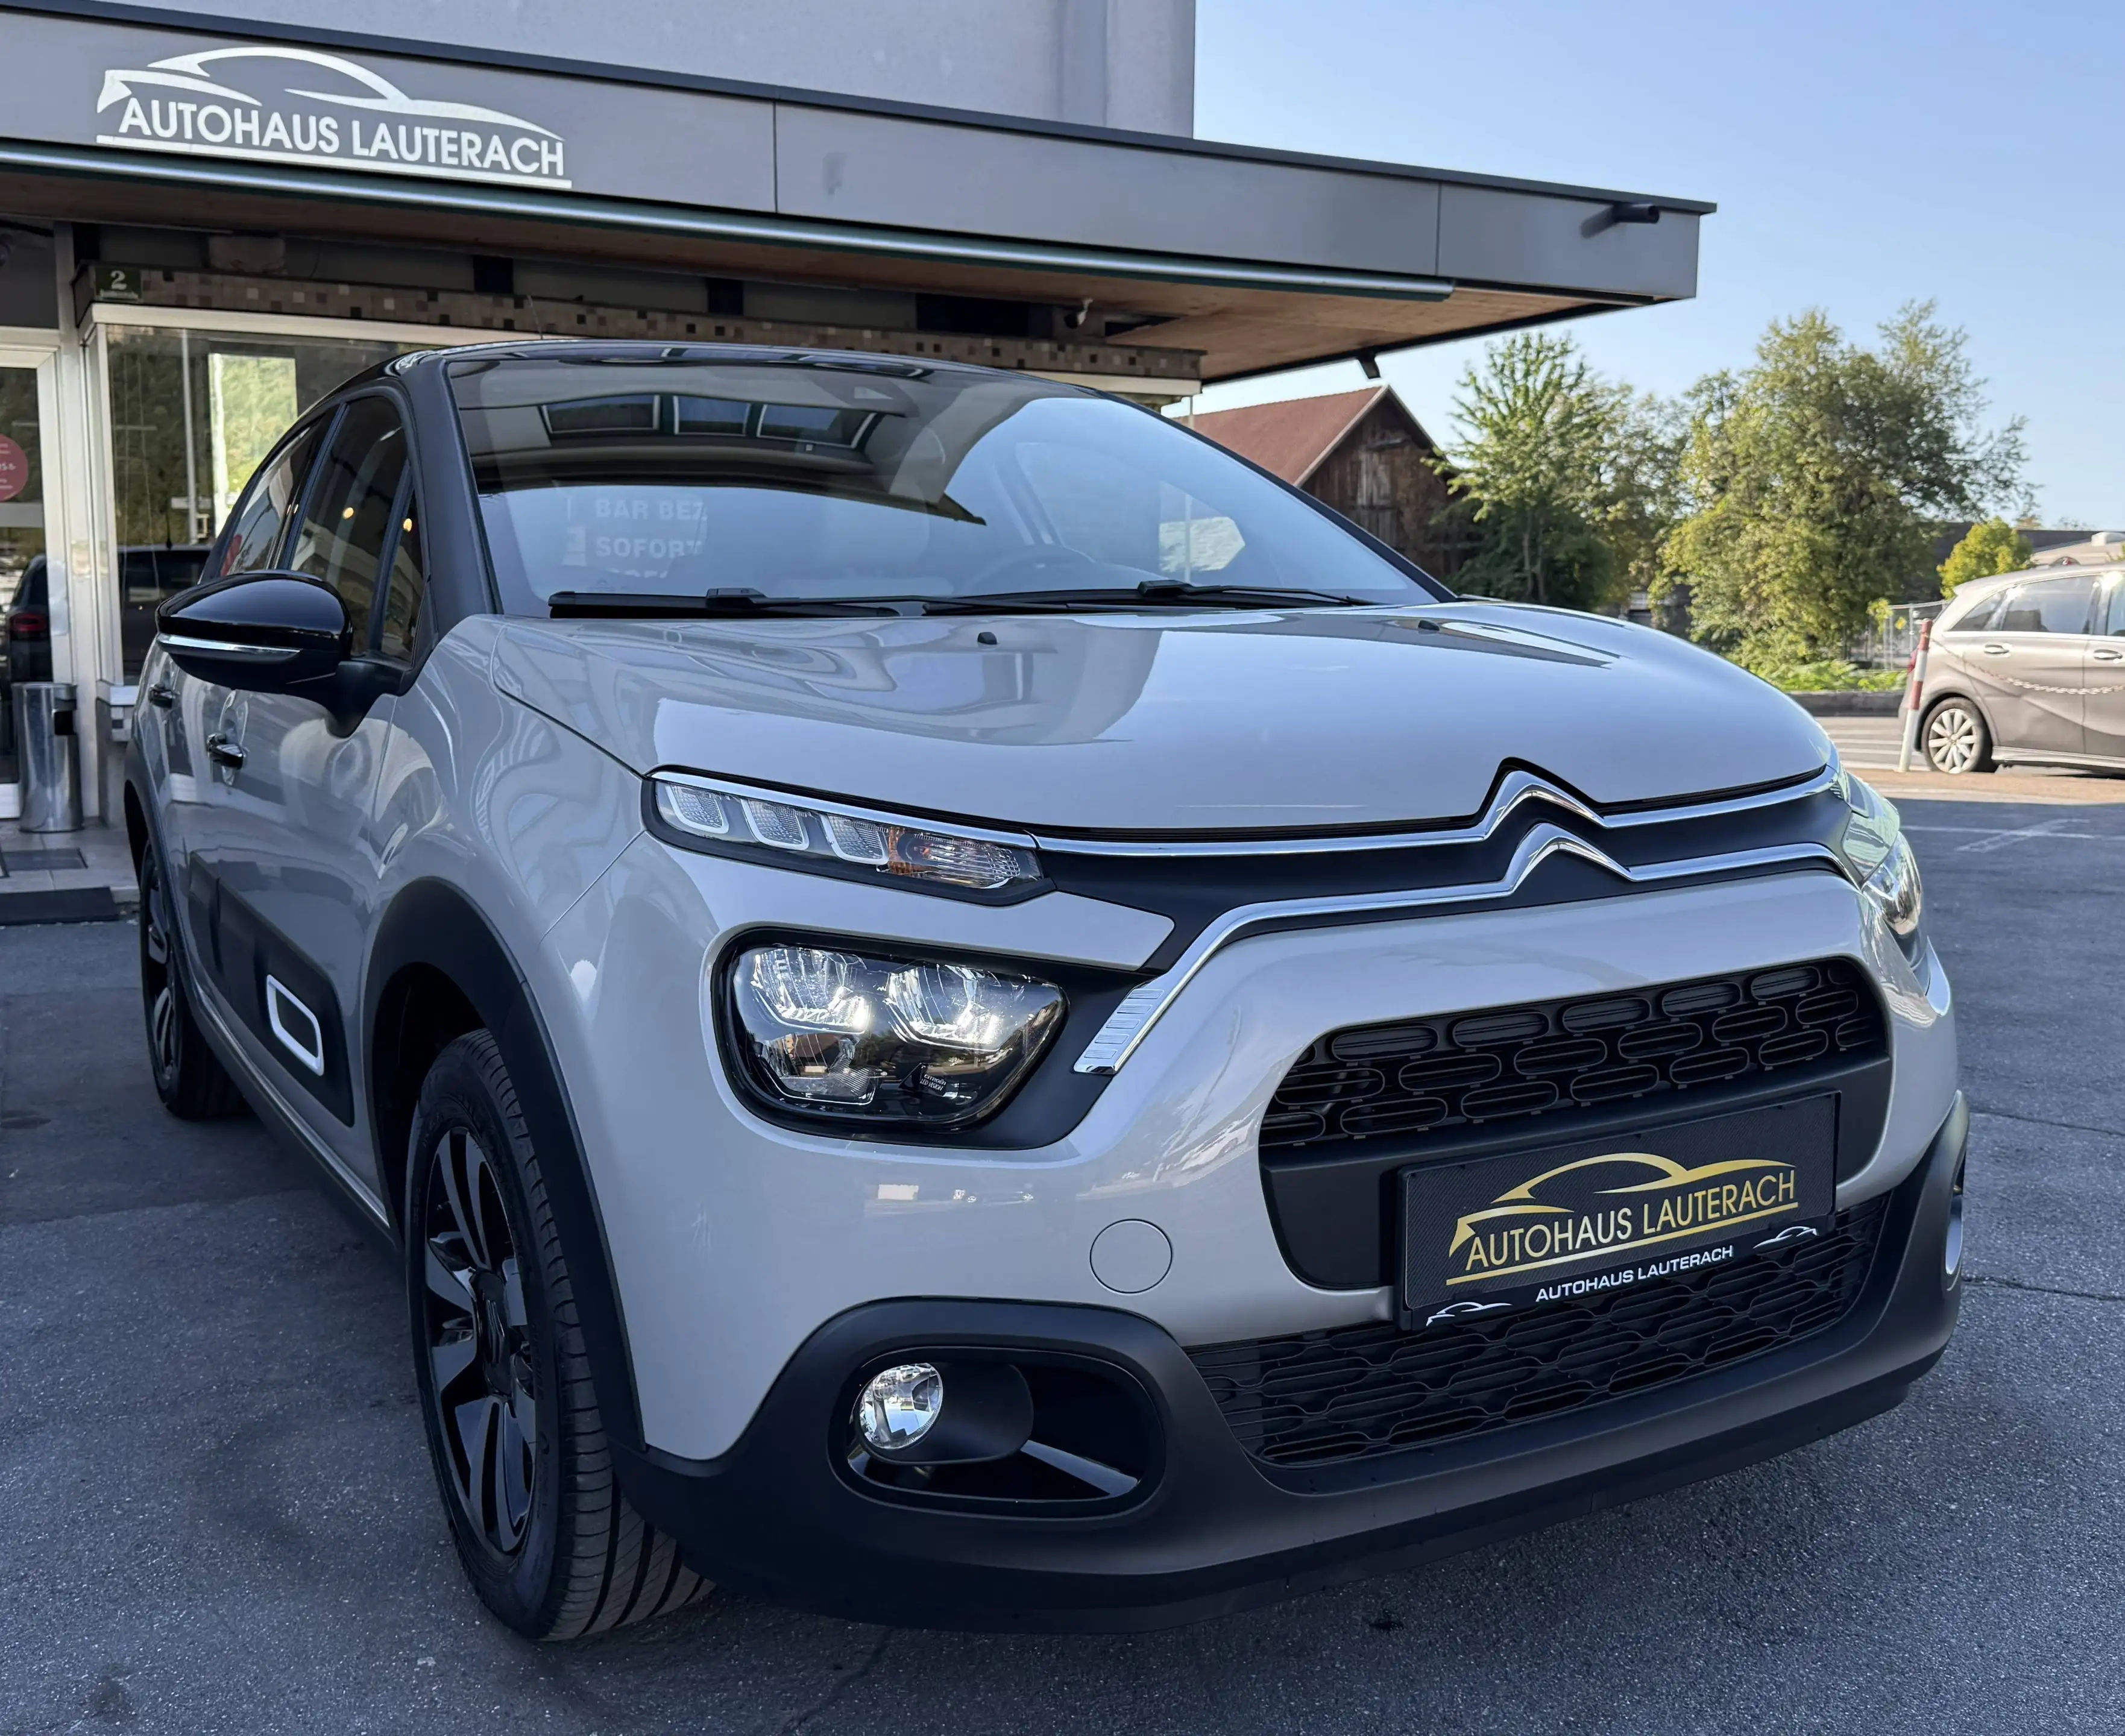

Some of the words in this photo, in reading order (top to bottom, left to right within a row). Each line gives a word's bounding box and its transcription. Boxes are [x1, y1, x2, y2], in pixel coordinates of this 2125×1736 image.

[118, 97, 339, 153] AUTOHAUS
[352, 120, 564, 176] LAUTERACH
[111, 271, 127, 290] 2
[596, 498, 648, 520] BAR
[1465, 1207, 1632, 1271] AUTOHAUS
[1643, 1169, 1795, 1234] LAUTERACH
[1535, 1269, 1634, 1303] AUTOHAUS
[1637, 1245, 1734, 1280] LAUTERACH
